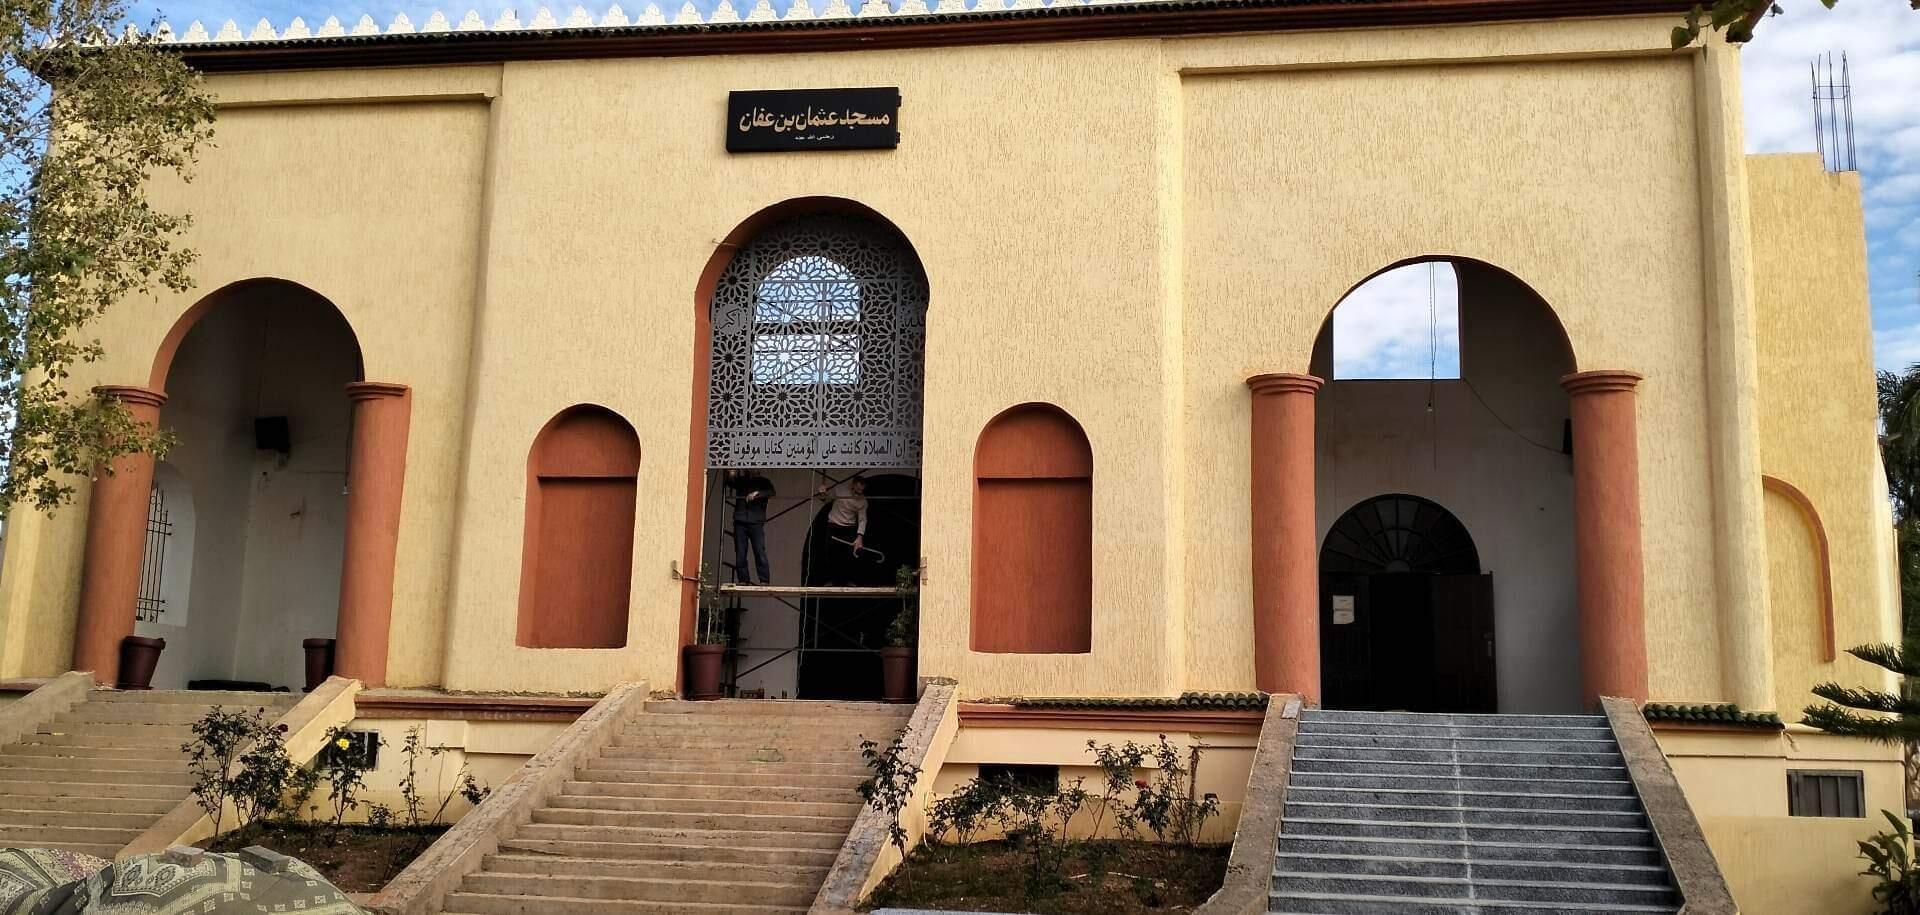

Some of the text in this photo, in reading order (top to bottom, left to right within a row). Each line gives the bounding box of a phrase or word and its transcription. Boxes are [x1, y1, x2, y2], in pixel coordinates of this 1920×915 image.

[739, 105, 890, 133] مسجد عثمان بن عفان
[733, 439, 761, 460] موقوتا
[764, 438, 785, 459] كتابا
[786, 438, 819, 460] المؤمنين
[822, 439, 837, 459] على
[840, 438, 862, 454] كانت
[863, 439, 892, 456] الصلاة
